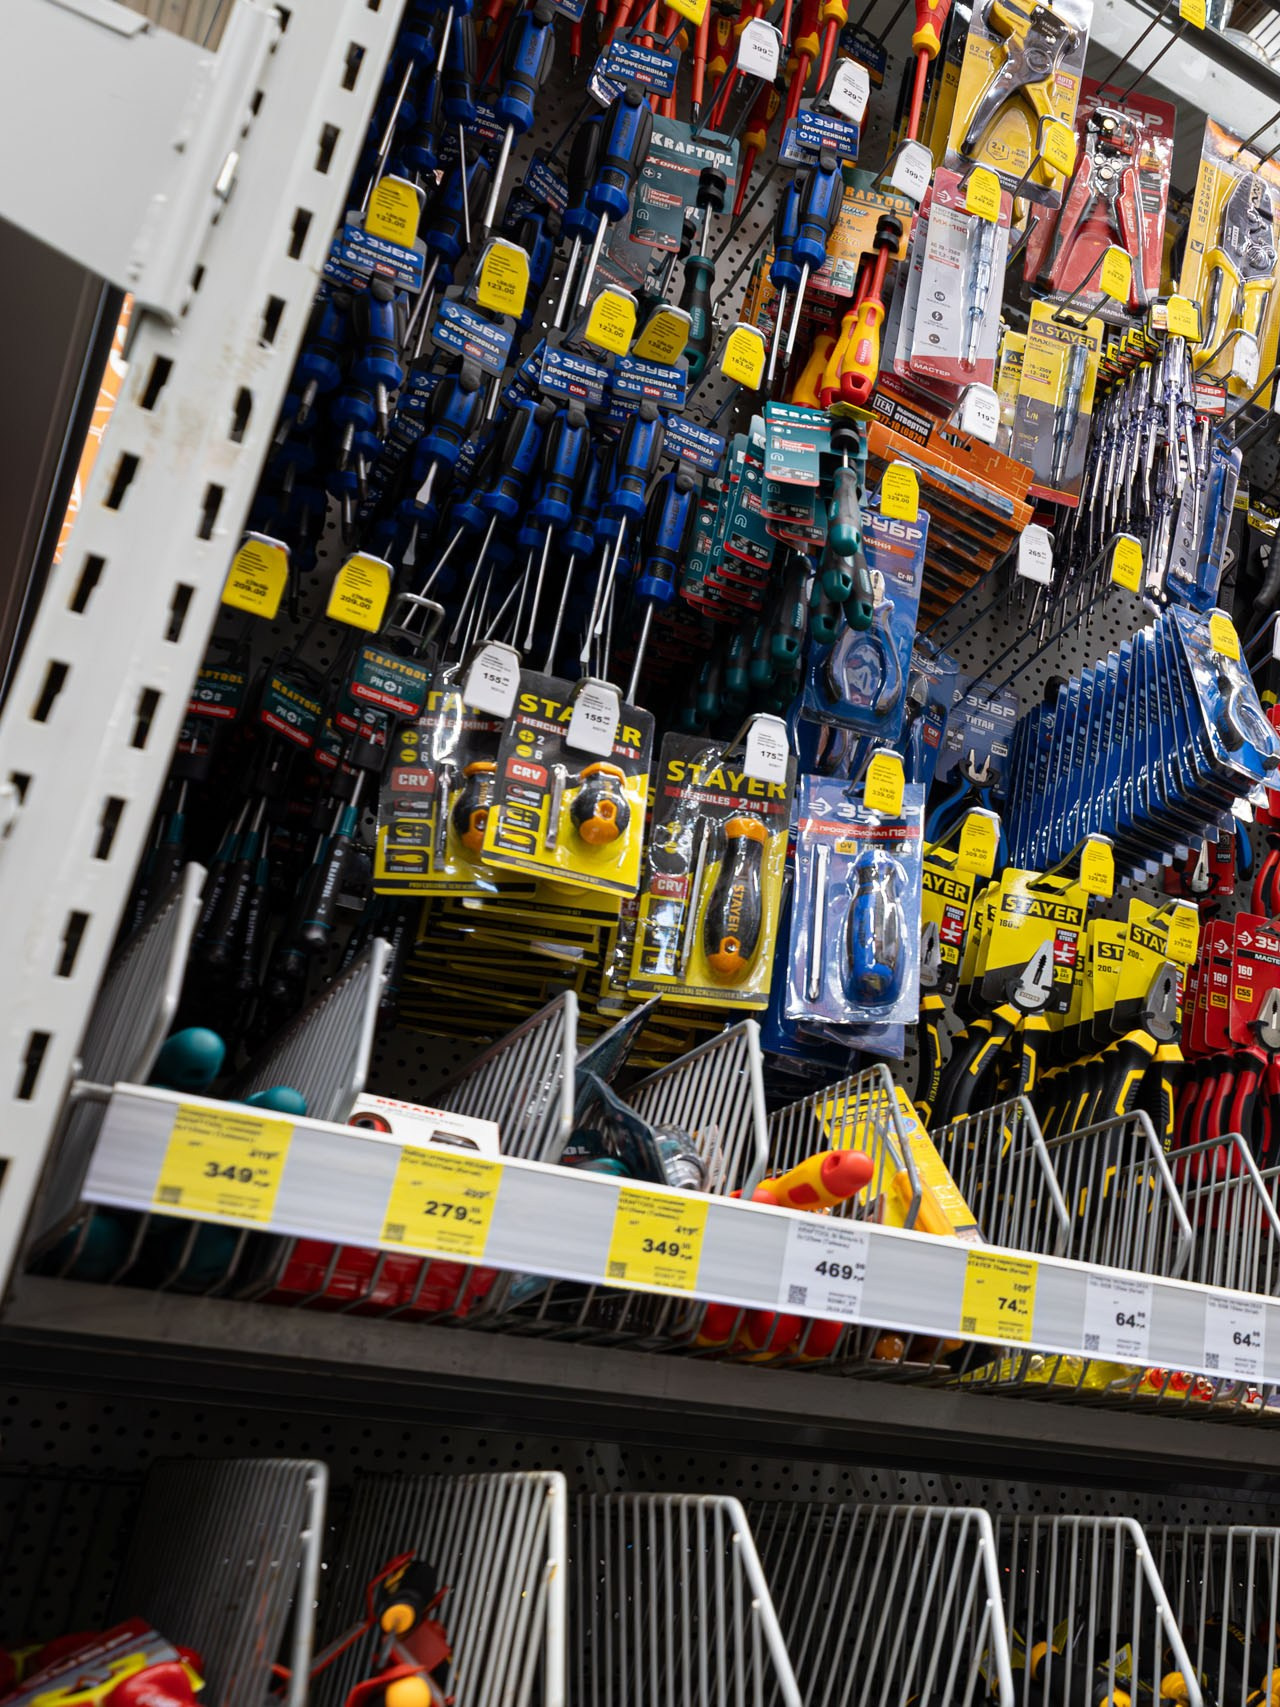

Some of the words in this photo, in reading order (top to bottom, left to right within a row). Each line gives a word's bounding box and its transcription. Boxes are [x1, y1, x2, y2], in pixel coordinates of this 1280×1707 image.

[630, 48, 673, 69] ЗУБР
[814, 118, 854, 134] ЗУБР
[650, 131, 734, 167] KRAFTOOL
[845, 186, 912, 211] RAFTOOL
[366, 238, 418, 262] ЗУБР
[460, 314, 506, 342] ЗУБР
[1045, 326, 1095, 349] STAYER
[562, 357, 608, 379] ЗУБР
[635, 362, 681, 380] ЗУБР
[771, 407, 832, 424] KRAFT
[679, 422, 720, 445] ЗУБР
[861, 512, 923, 540] ЗУБР
[363, 650, 428, 681] KRAFTOOL
[966, 695, 1016, 717] ЗУБР
[518, 693, 642, 748] STAER
[522, 717, 568, 736] HERCULE
[965, 714, 995, 731] ТИТАН
[398, 774, 428, 786] CRV
[512, 764, 541, 780] CRV
[666, 760, 787, 799] STAYER
[680, 790, 730, 806] HERCULES
[657, 878, 683, 892] CRV
[922, 872, 968, 900] AYER
[728, 885, 745, 932] STAYER
[1003, 895, 1079, 922] STAYER
[1133, 925, 1167, 954] STAY
[1213, 972, 1227, 983] 160
[1237, 965, 1252, 976] 160
[204, 1161, 253, 1184] 349
[425, 1200, 468, 1221] 279
[642, 1238, 680, 1257] 349
[815, 1260, 853, 1280] 469
[998, 1297, 1018, 1312] 74
[1116, 1312, 1135, 1328] 64
[1233, 1331, 1252, 1347] 64
